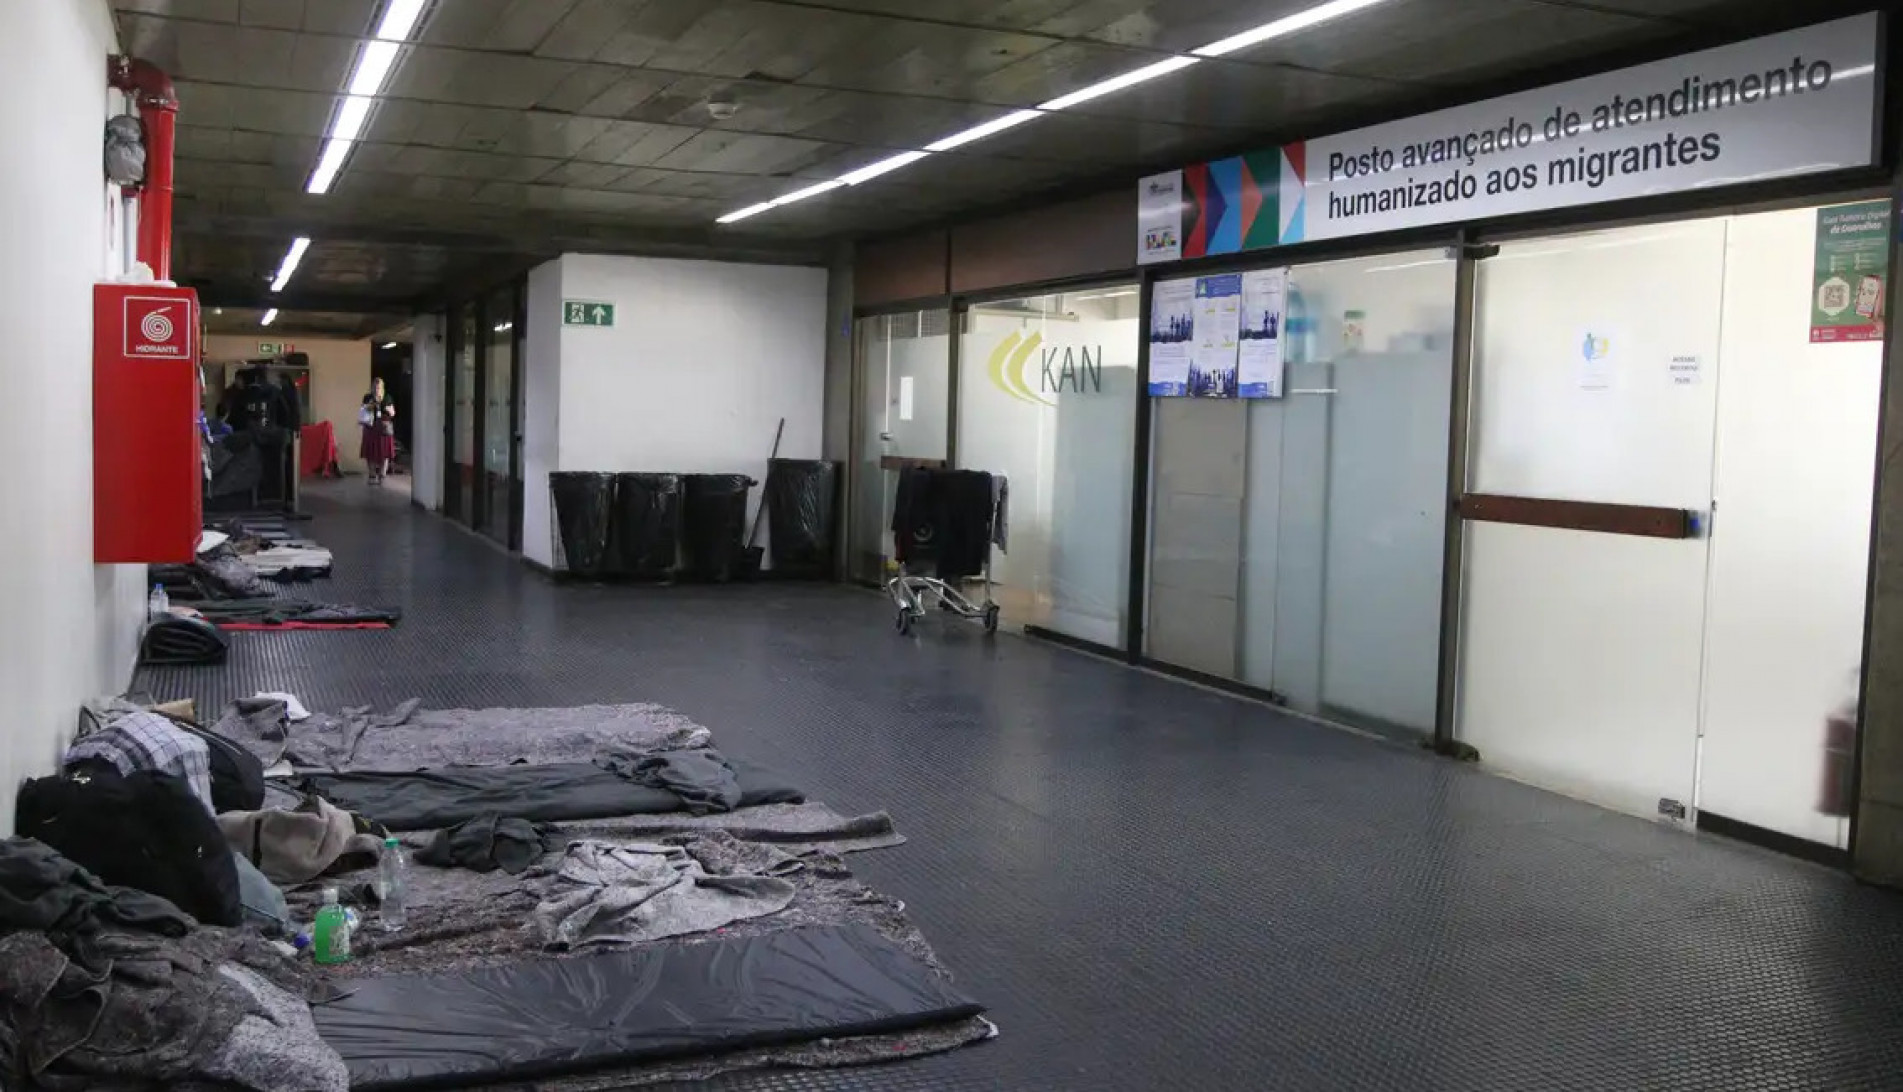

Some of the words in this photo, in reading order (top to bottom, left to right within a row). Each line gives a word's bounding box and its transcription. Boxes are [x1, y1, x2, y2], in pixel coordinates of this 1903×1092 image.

[1329, 146, 1394, 181] Posto
[1402, 117, 1533, 166] avançado
[1543, 106, 1582, 142] de
[1591, 56, 1832, 133] atendimento
[1328, 170, 1477, 219] humanizado
[1486, 164, 1538, 195] aos
[1548, 132, 1721, 188] migrantes
[135, 345, 179, 354] HIDRANTE
[1041, 345, 1101, 393] KAN
